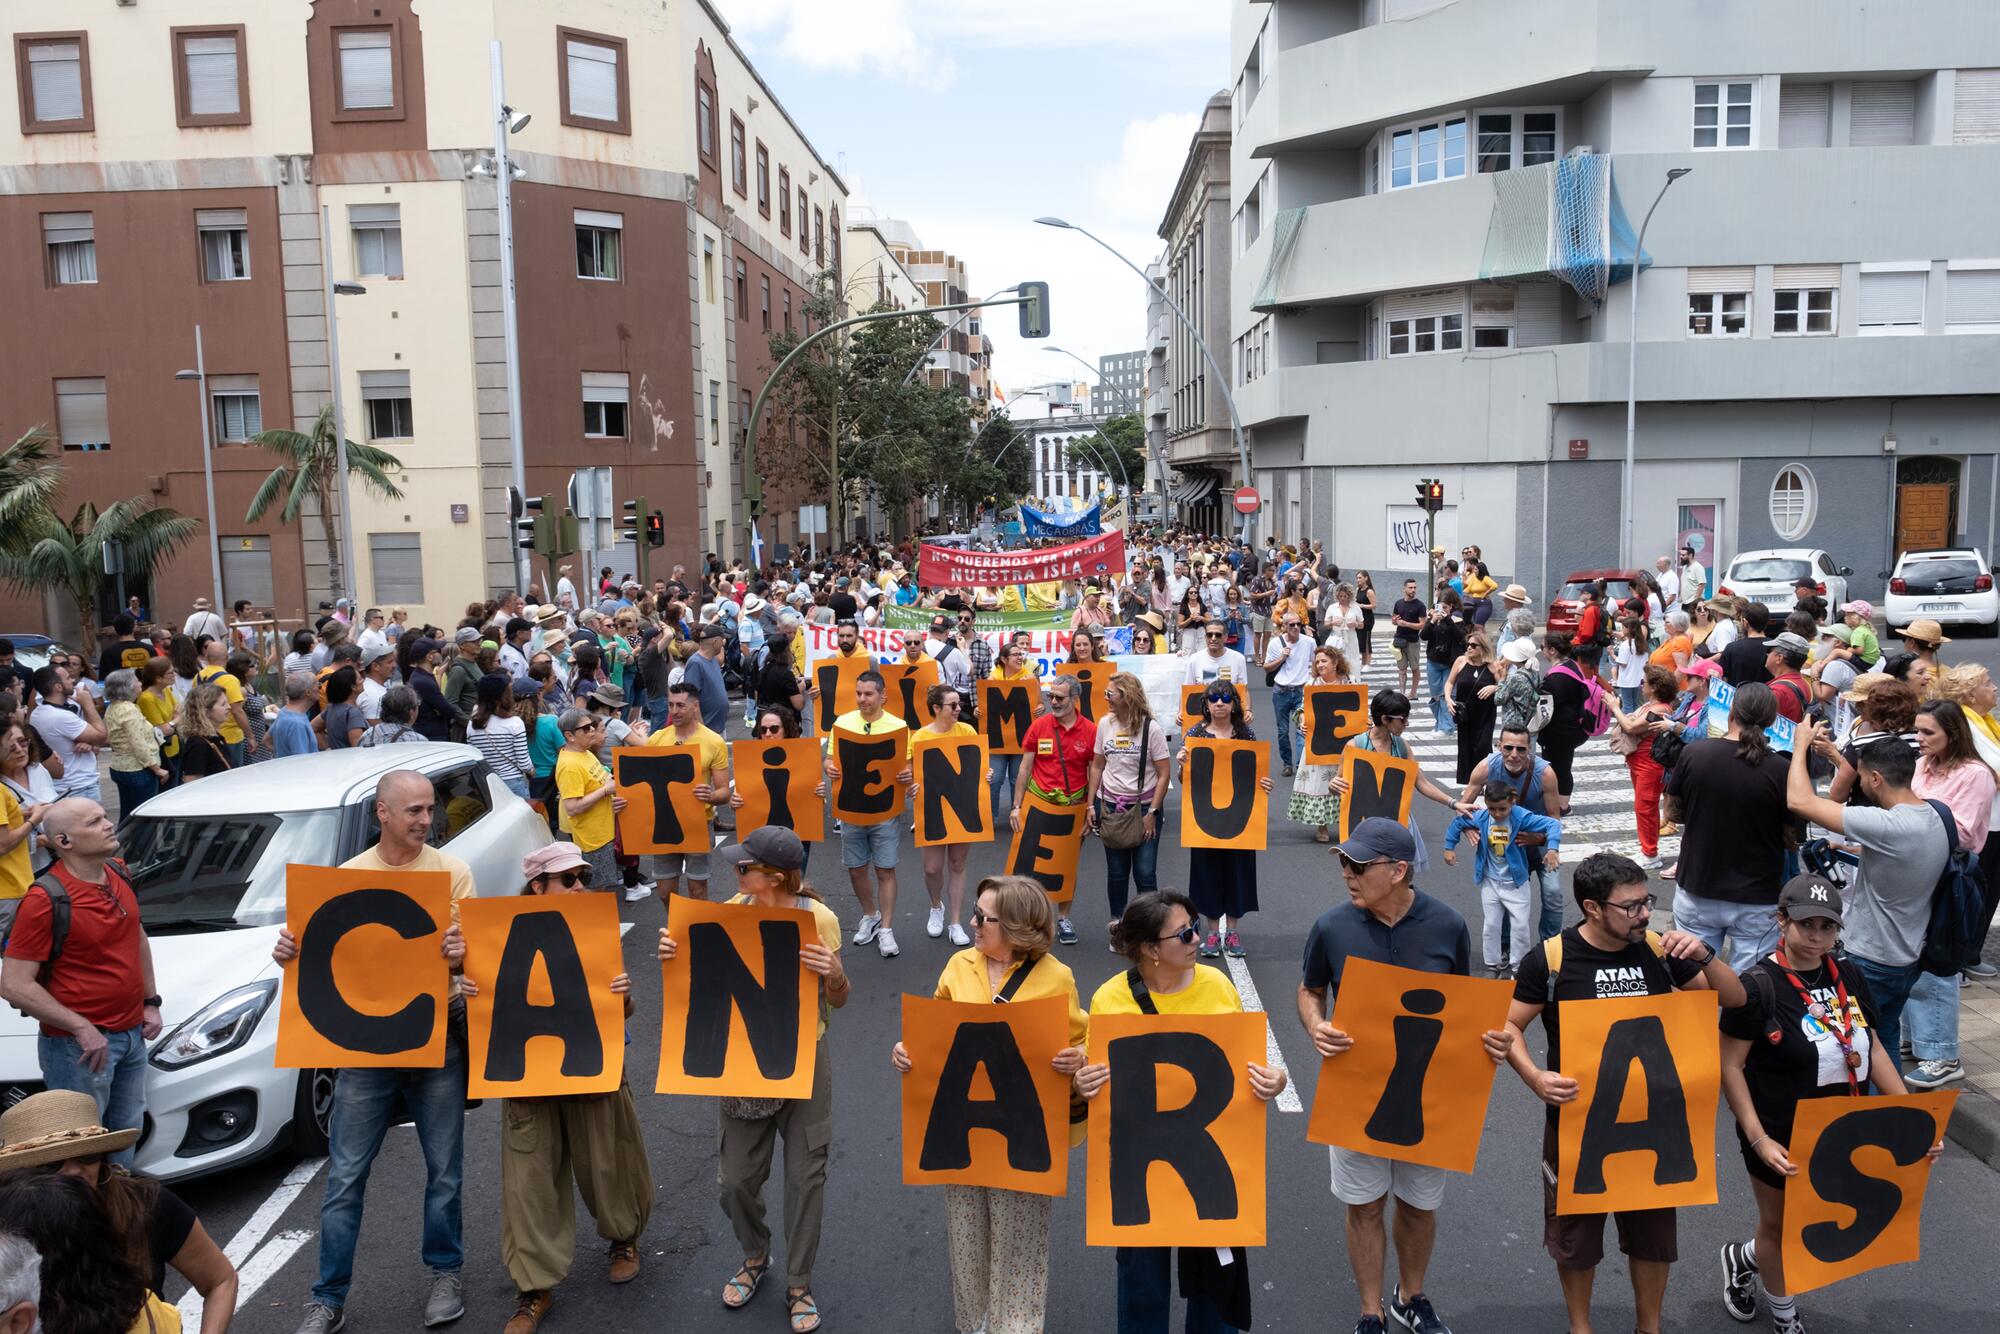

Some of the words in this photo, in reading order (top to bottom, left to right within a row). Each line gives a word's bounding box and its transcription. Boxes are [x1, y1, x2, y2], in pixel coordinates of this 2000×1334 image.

[932, 552, 950, 563] NO
[955, 555, 1029, 568] QUEREMOS
[1034, 554, 1058, 564] VER
[1063, 542, 1106, 558] MORIR
[951, 567, 1036, 582] NUESTRA
[1043, 561, 1083, 579] ISLA
[1032, 521, 1096, 536] MEGAOBRAS
[986, 686, 1033, 750] M
[1311, 691, 1361, 756] E
[618, 753, 695, 845] T
[838, 737, 897, 815] E
[923, 744, 983, 842] N
[1190, 746, 1257, 839] U
[1012, 804, 1076, 892] E
[298, 888, 438, 1056] C
[484, 910, 604, 1082] A
[683, 919, 801, 1080] N
[1594, 966, 1645, 983] ATAN
[919, 1021, 1053, 1173] A
[1108, 1031, 1239, 1227] R
[1573, 1015, 1698, 1195] A
[1801, 1105, 1938, 1264] S
